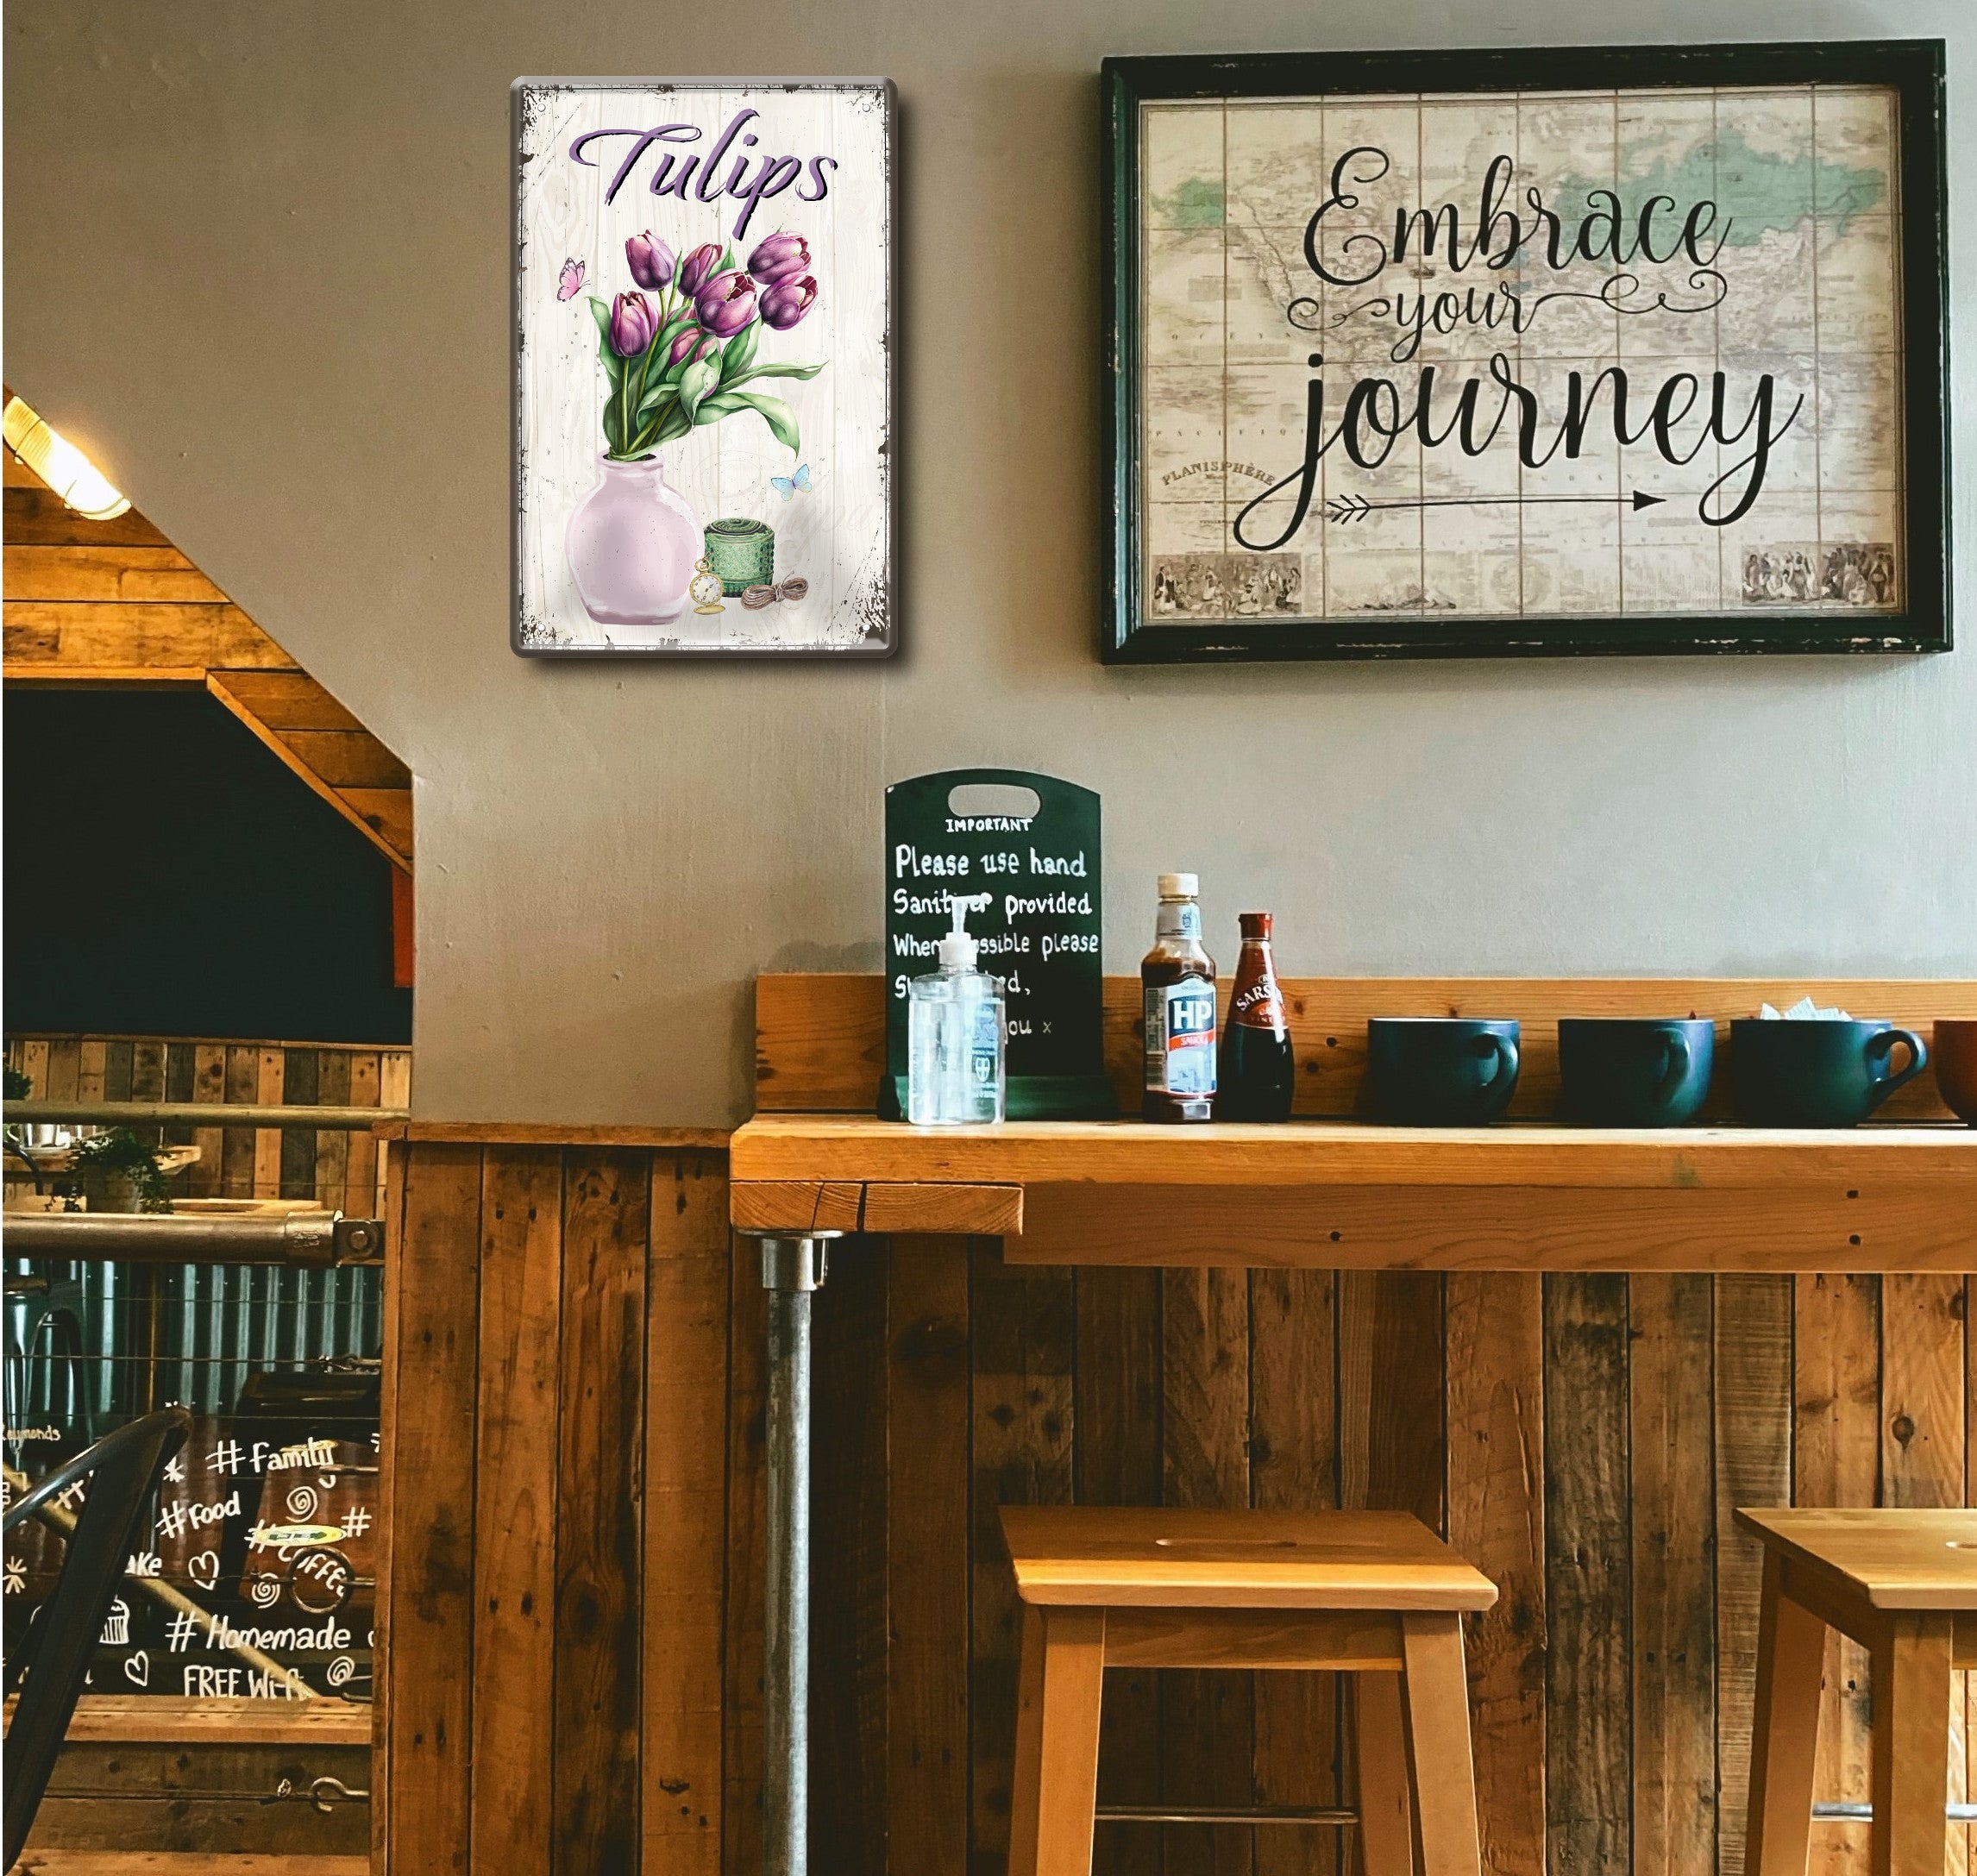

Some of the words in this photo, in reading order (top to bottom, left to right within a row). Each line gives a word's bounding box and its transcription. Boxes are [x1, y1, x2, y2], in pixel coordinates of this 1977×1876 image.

[569, 108, 838, 241] Tulips
[1303, 147, 1733, 285] Embrace
[1233, 352, 1804, 551] journey
[1161, 461, 1276, 486] PLANISPHÈRE
[945, 817, 1035, 833] IMPORTANT
[895, 844, 970, 878] Please
[979, 852, 1020, 875] use
[1029, 846, 1088, 878] hand
[1005, 890, 1093, 925] provided
[1041, 934, 1099, 962] please
[1173, 1001, 1213, 1030] HP
[184, 1665, 242, 1698] FREE
